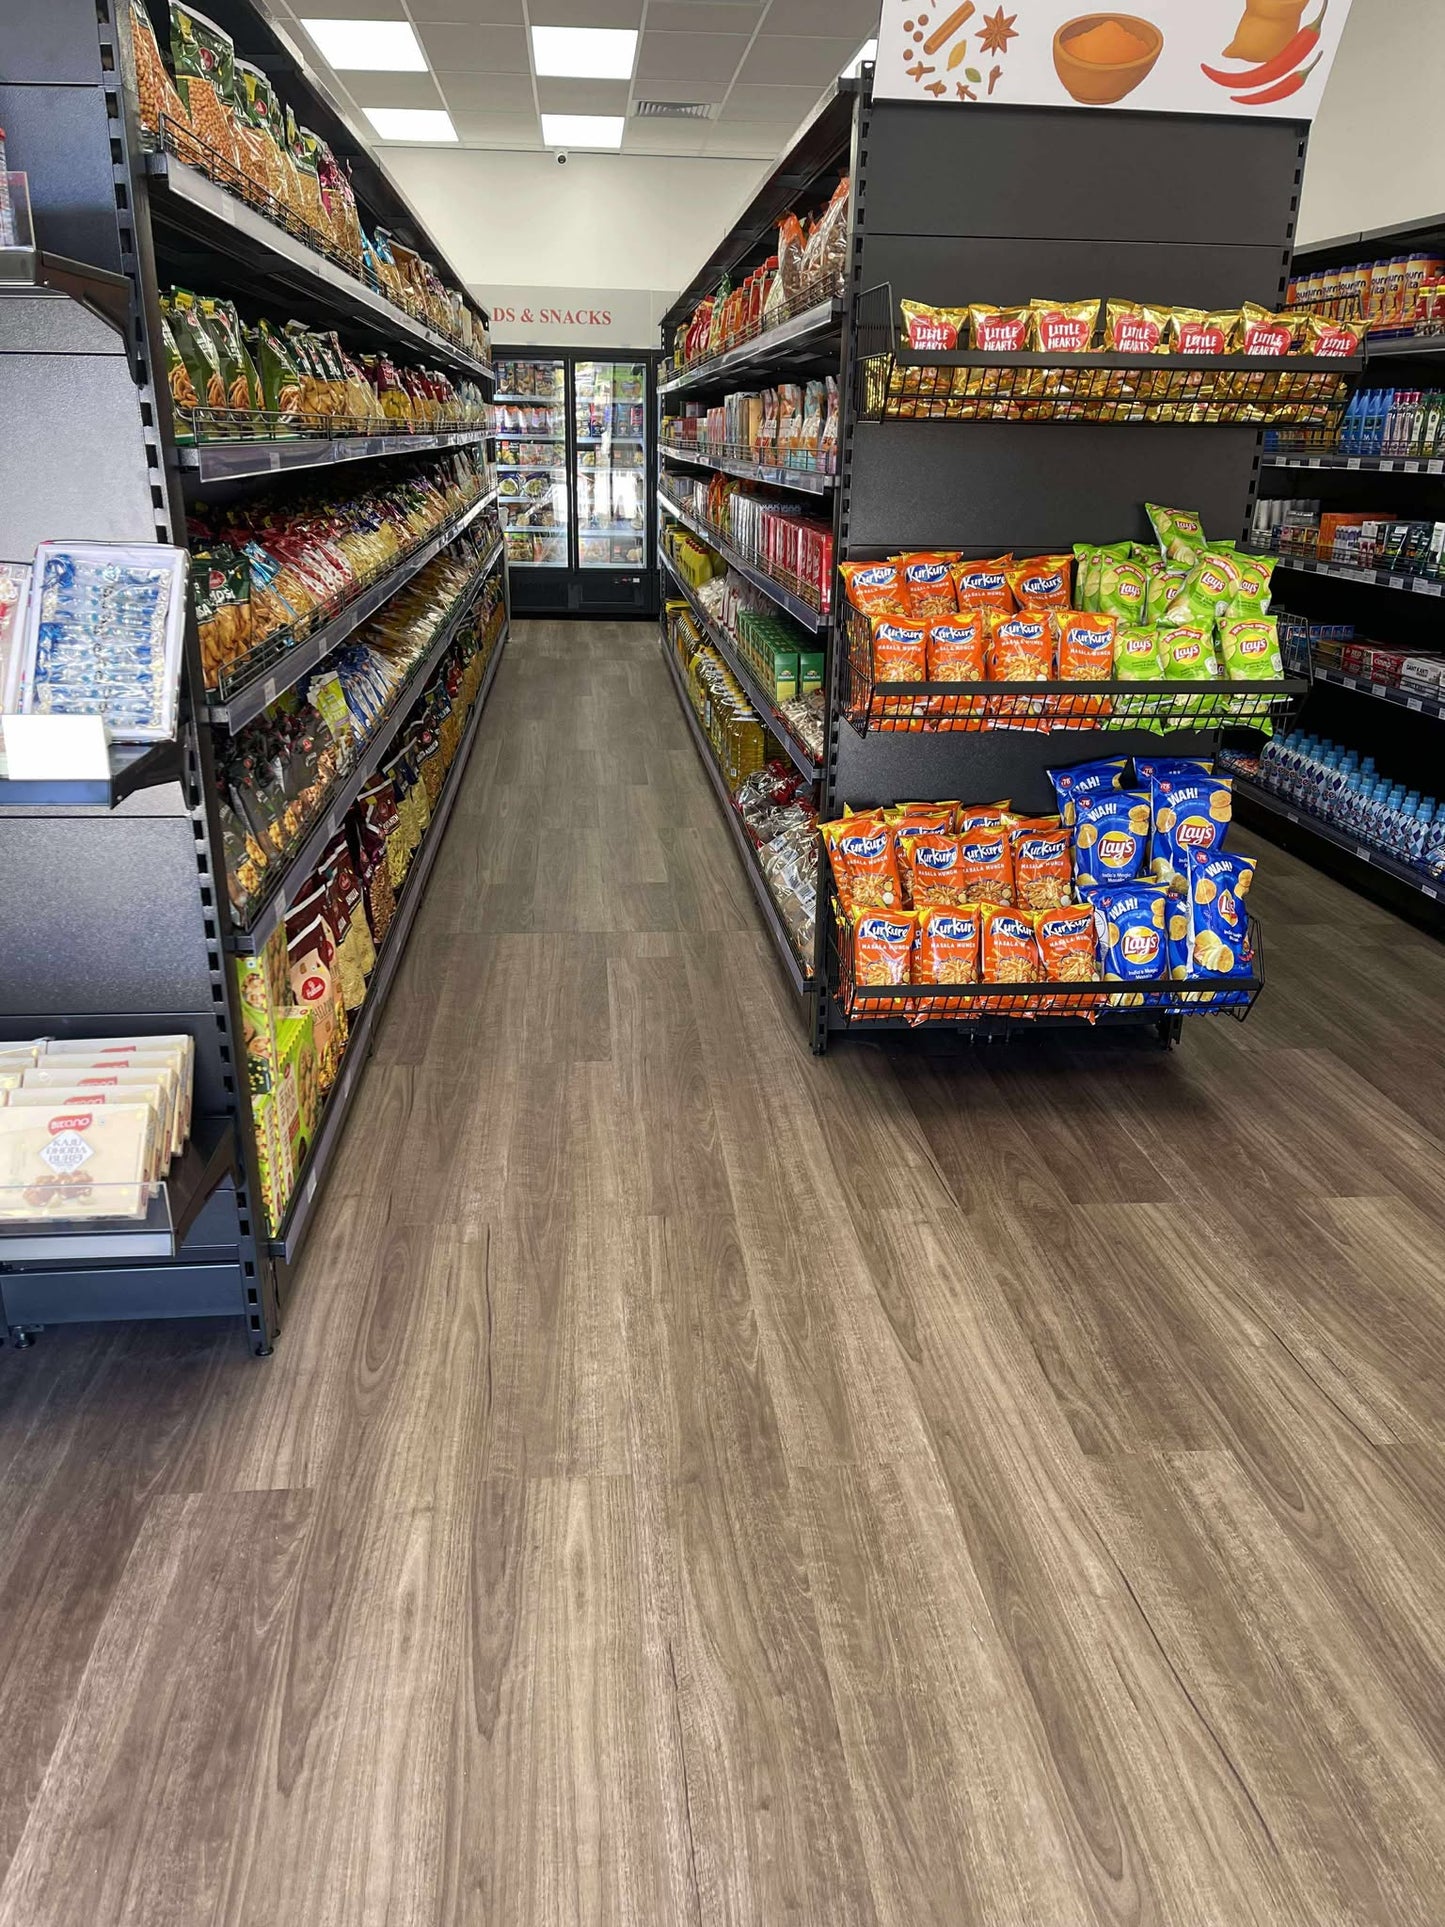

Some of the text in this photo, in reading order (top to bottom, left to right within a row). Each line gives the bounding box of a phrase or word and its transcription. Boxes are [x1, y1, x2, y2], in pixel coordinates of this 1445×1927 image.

[492, 307, 612, 326] DS & SNACKS
[916, 326, 949, 341] LITTLE
[985, 326, 1018, 341] LITTLE
[1048, 322, 1080, 337] LITTLE
[1122, 325, 1150, 340] LITTLE
[983, 340, 1018, 351] HEARTS
[1047, 336, 1081, 350] HEARTS
[1119, 339, 1150, 352] HEARTS
[1185, 333, 1217, 348] LITTLE
[1252, 331, 1283, 348] LITTLE
[1321, 337, 1351, 350] LITTLE
[1247, 345, 1280, 356] HEARTS
[1023, 575, 1063, 594] Kurkure
[878, 623, 924, 641] Kurkure
[930, 626, 976, 642] Kurkure
[1070, 628, 1113, 646] Kurkure
[1167, 788, 1198, 808] WAH!
[1088, 803, 1117, 822] WAH!
[841, 836, 887, 857] Kurkure
[1021, 841, 1067, 860] Kurkure
[917, 848, 958, 868] Kurkure
[1205, 860, 1233, 877] WAH!
[1109, 897, 1139, 920] WAH!
[862, 920, 909, 940] Kurkure
[995, 917, 1034, 937] Kurkur
